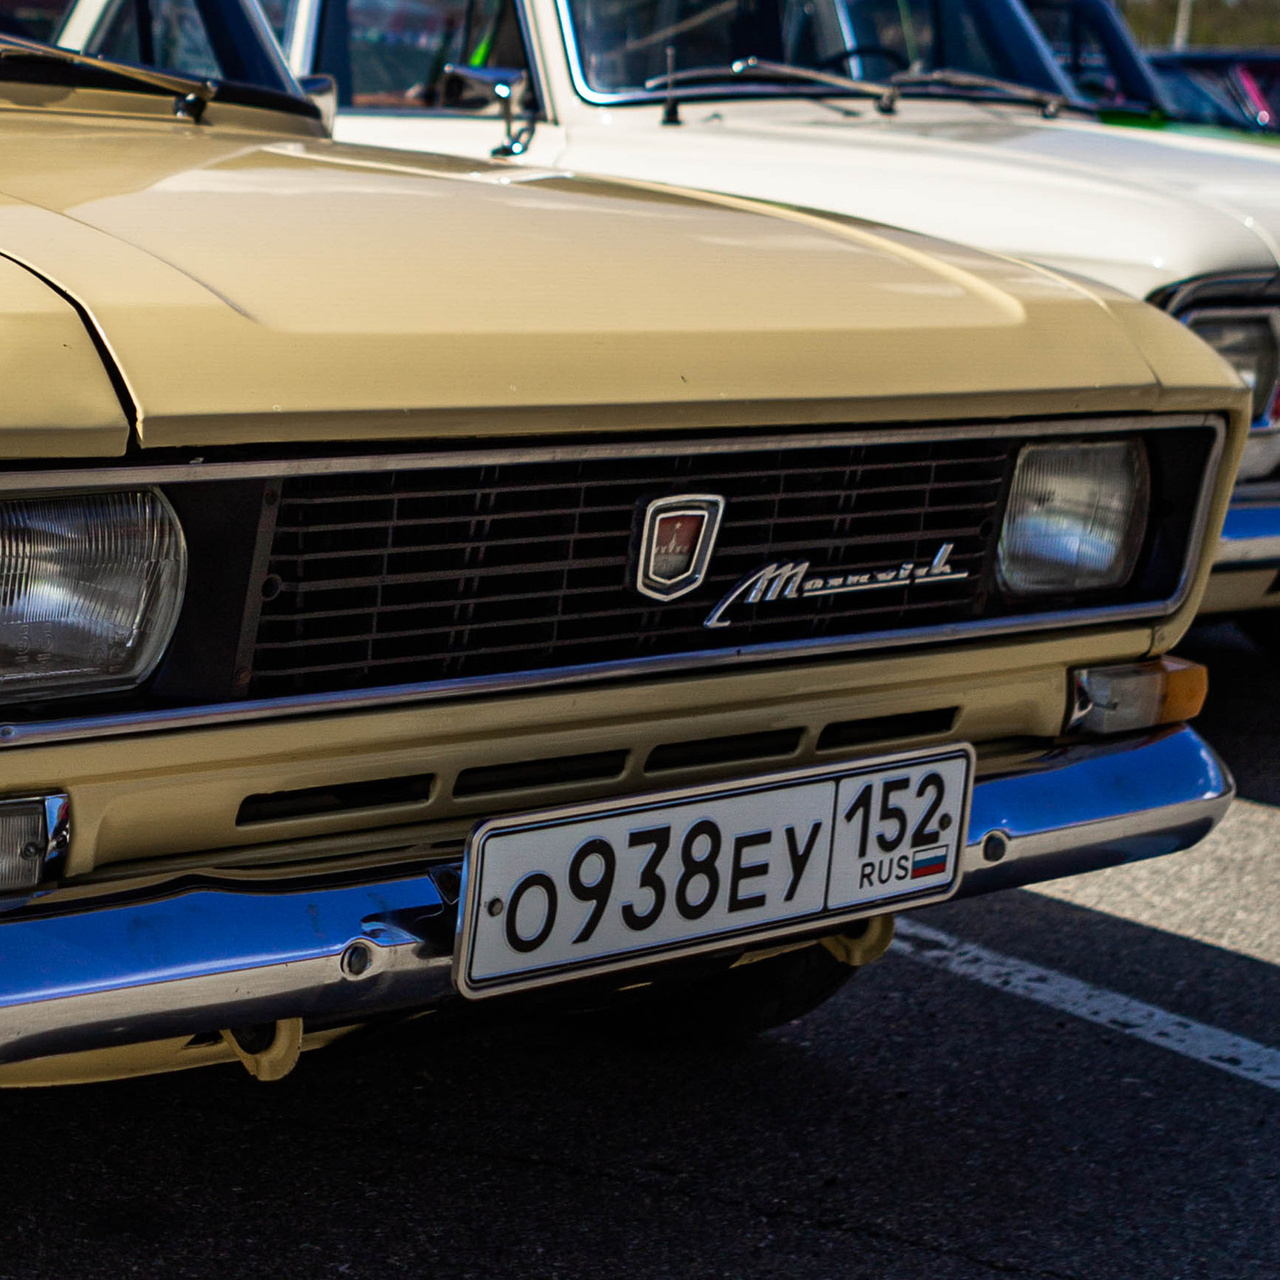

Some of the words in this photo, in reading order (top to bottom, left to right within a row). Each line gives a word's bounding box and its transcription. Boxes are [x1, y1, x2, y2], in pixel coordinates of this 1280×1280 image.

[506, 819, 822, 953] О938ЕУ
[844, 771, 944, 857] 152
[859, 851, 909, 889] RUS
